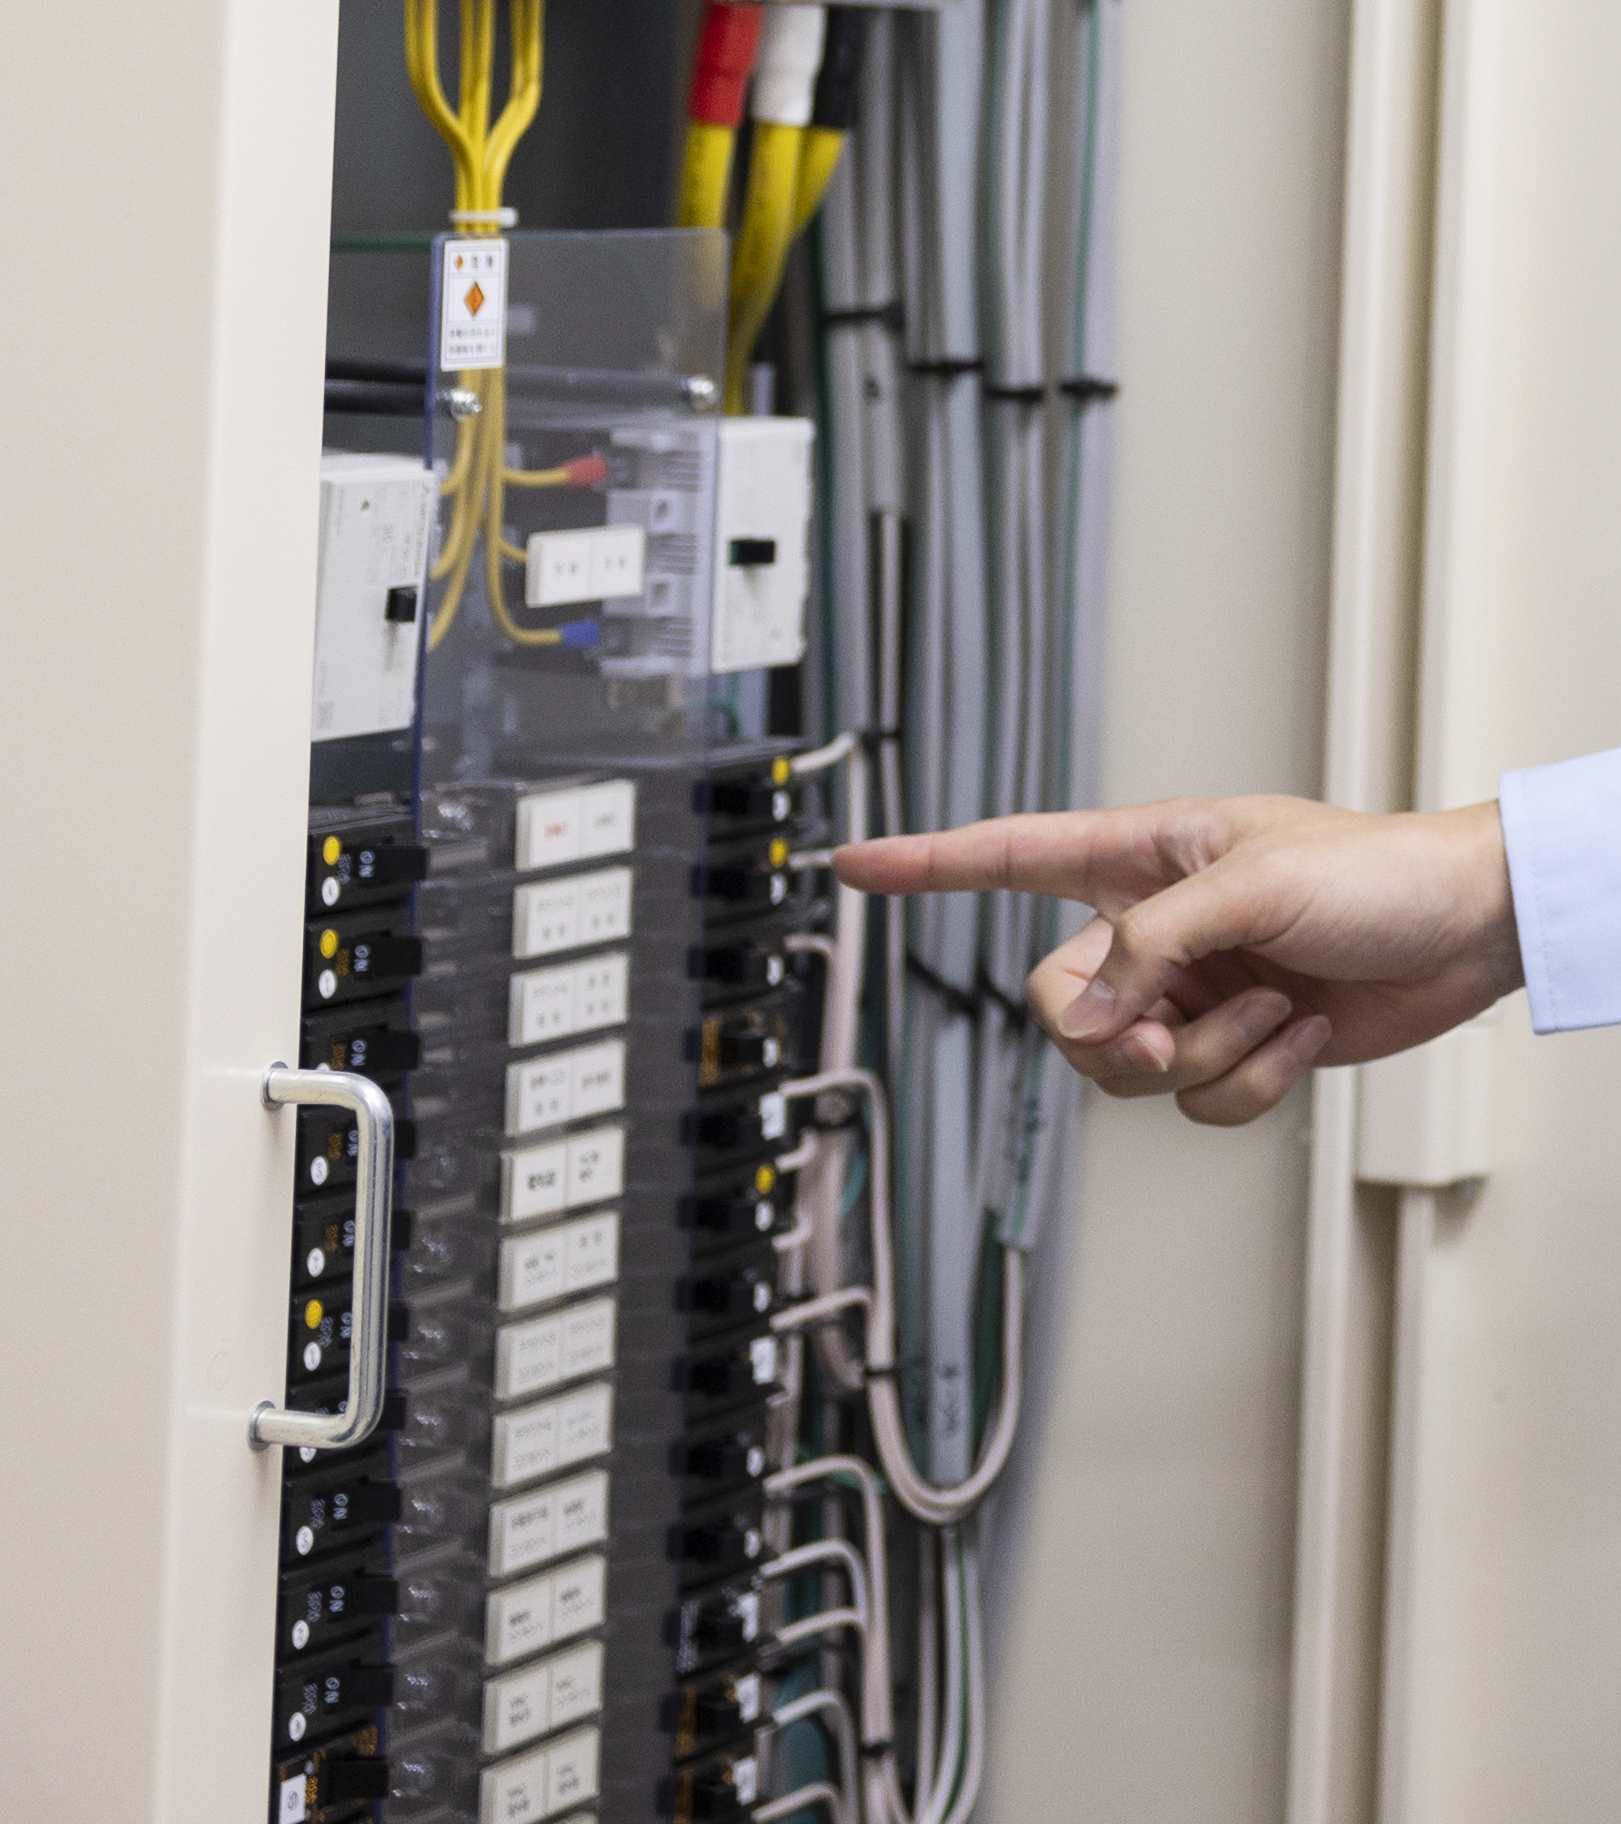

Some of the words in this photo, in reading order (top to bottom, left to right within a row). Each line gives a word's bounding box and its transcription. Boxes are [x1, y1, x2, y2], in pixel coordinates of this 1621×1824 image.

[359, 850, 375, 878] ON
[354, 944, 369, 972] ON
[351, 1039, 366, 1067] ON
[333, 1493, 348, 1520] ON
[329, 1586, 345, 1613] ON
[324, 1676, 340, 1704] ON
